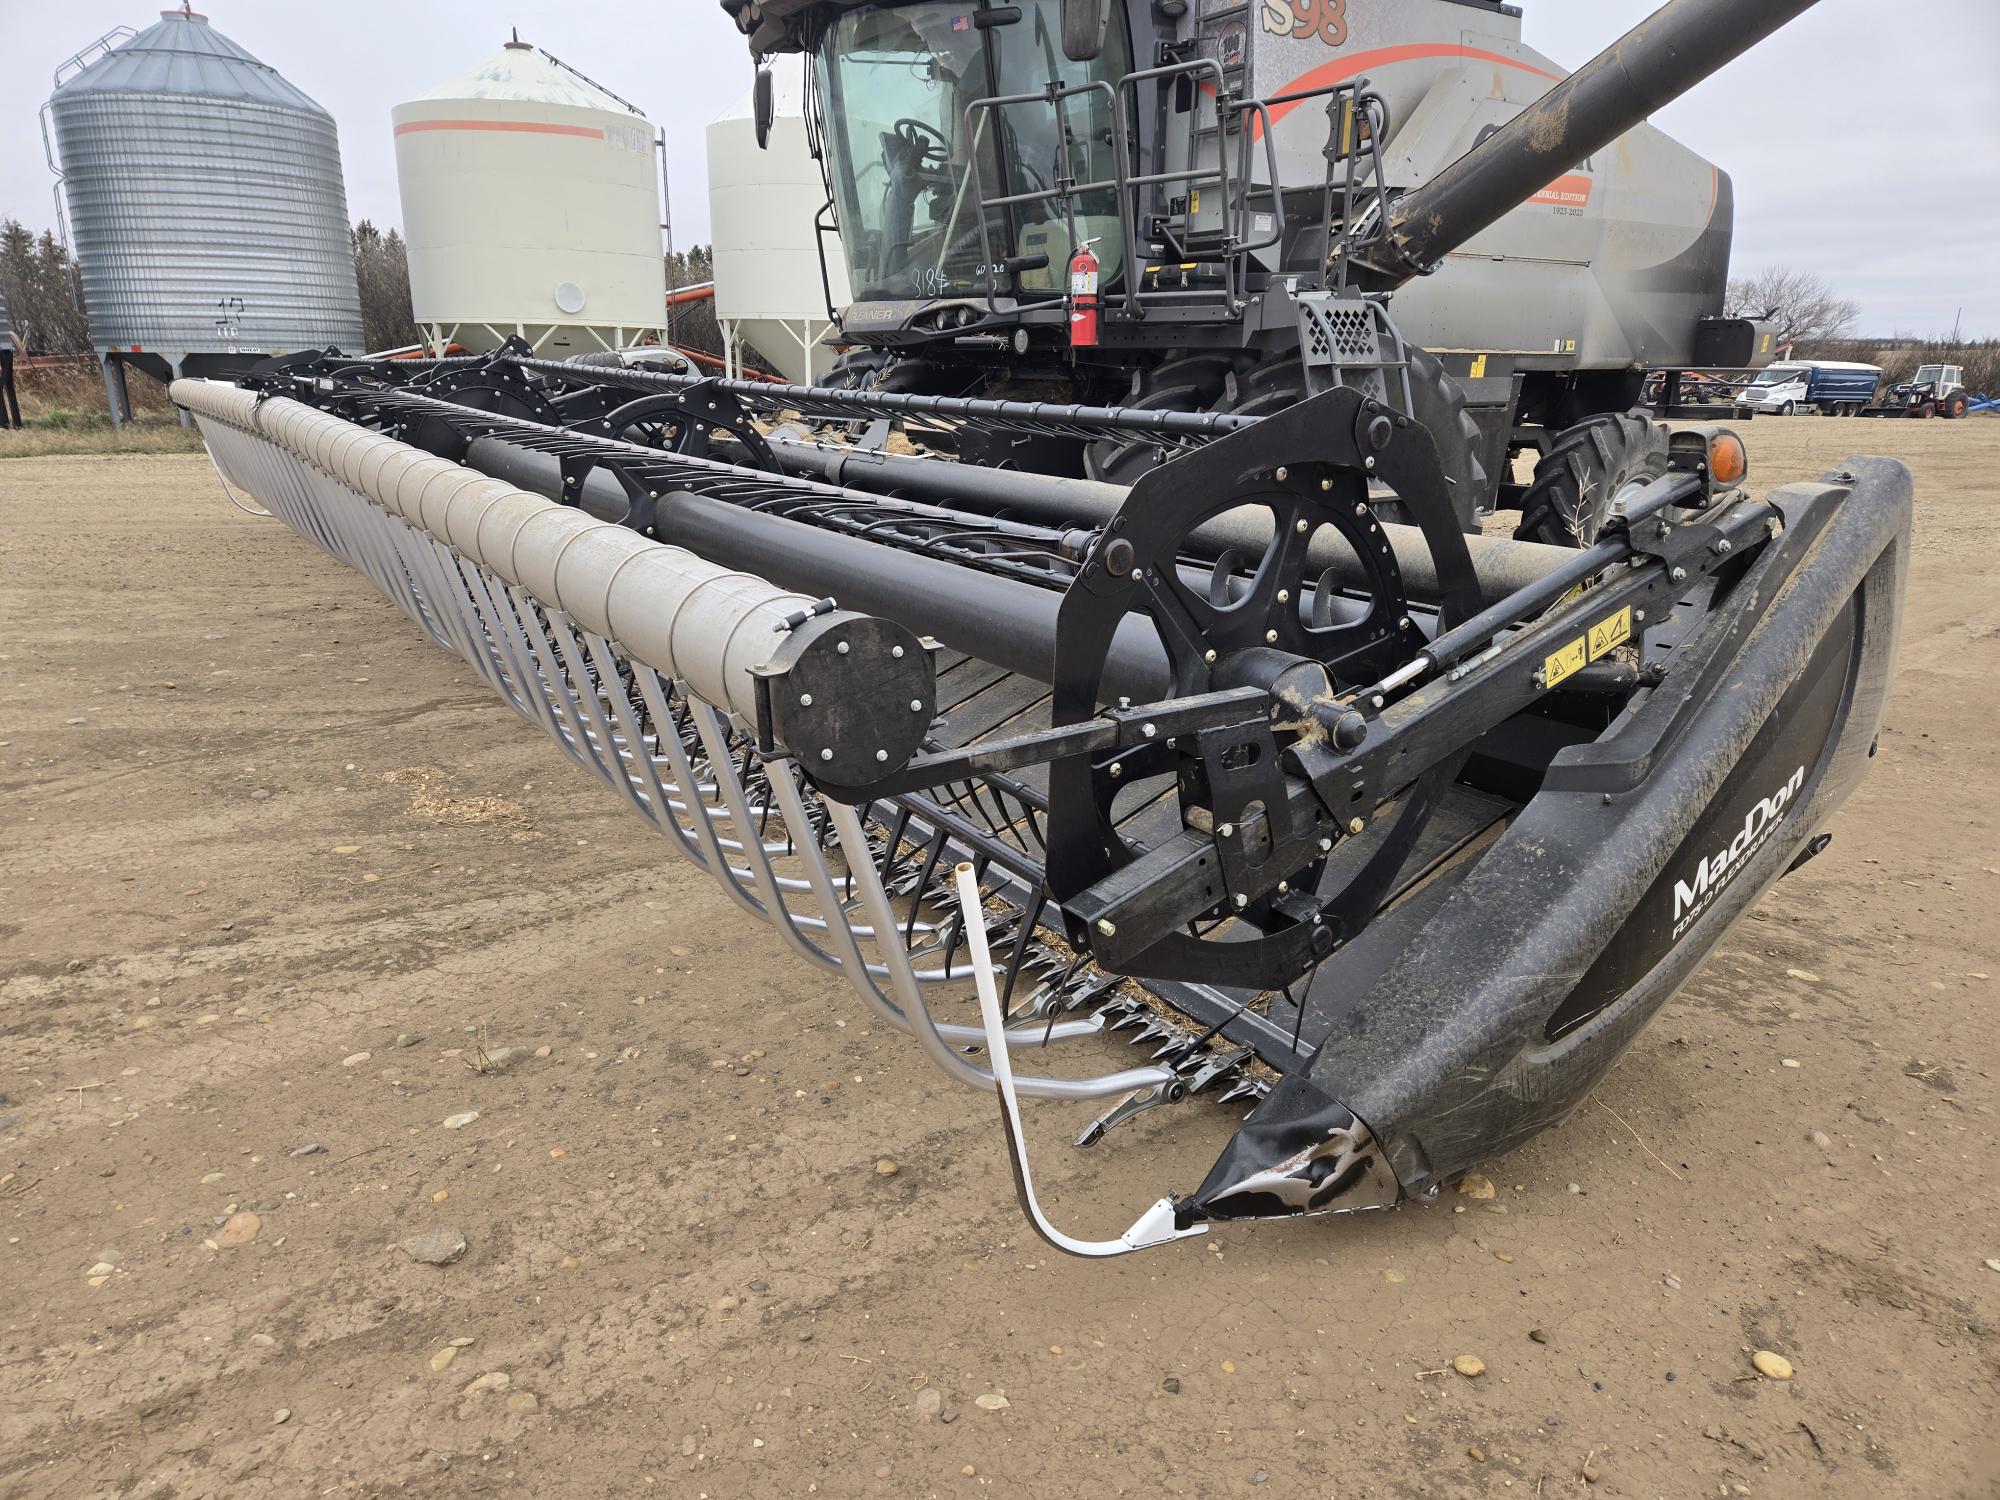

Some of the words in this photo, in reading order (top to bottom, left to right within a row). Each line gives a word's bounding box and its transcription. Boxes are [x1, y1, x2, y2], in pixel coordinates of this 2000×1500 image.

[1261, 0, 1347, 46] S98
[1552, 206, 1584, 216] 1923-2023
[1560, 191, 1587, 202] EDITION
[1673, 765, 1805, 922] MacDon
[1714, 812, 1784, 895] FLEXDRAPER
